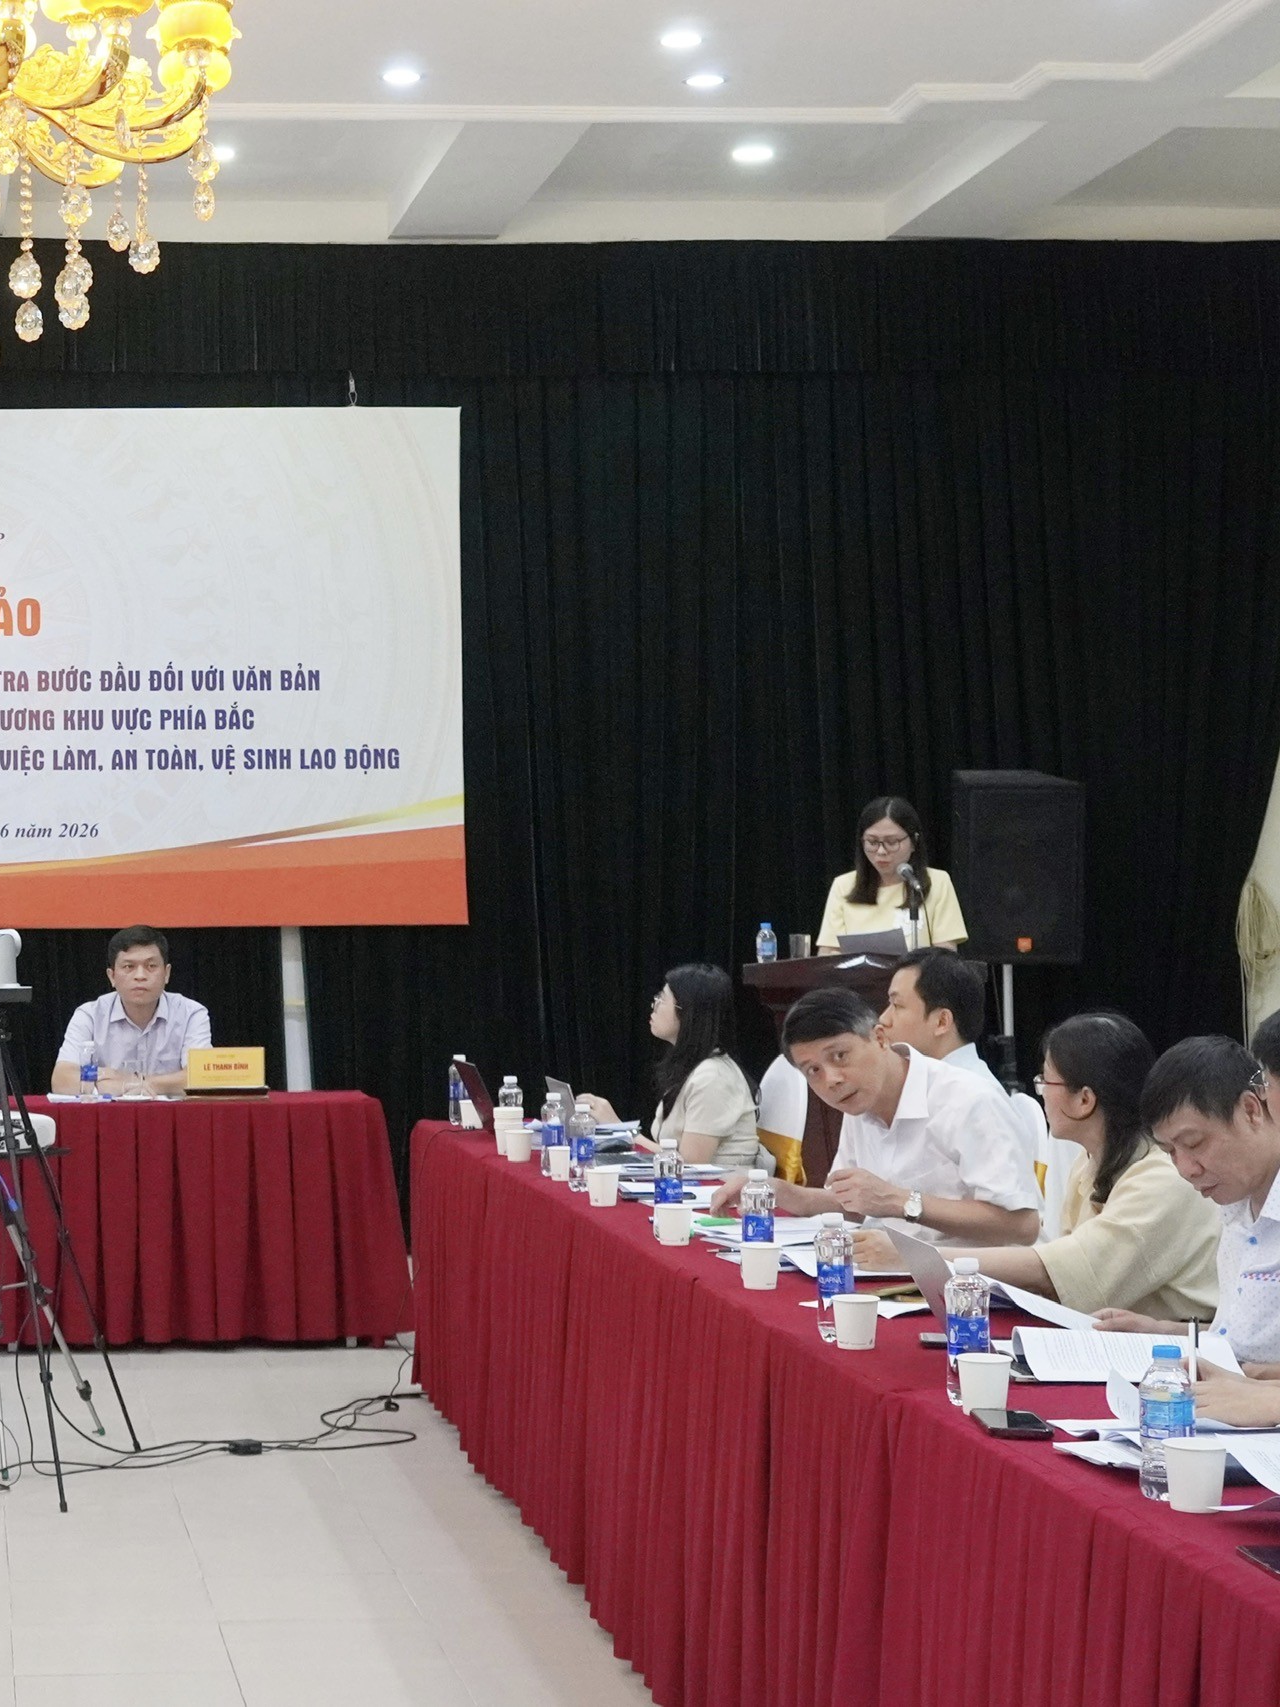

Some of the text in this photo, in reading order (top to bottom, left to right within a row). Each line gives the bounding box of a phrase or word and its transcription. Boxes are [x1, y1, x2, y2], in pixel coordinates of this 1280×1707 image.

[37, 666, 91, 692] BƯỚC
[100, 662, 140, 691] ĐẦU
[148, 662, 183, 691] ĐỐI
[192, 665, 224, 691] VỚI
[233, 666, 271, 691] VĂN
[281, 663, 320, 691] BẢN
[64, 710, 103, 730] KHU
[112, 708, 151, 735] VỰC
[160, 705, 206, 730] PHÍA
[215, 702, 254, 730] BẮC
[0, 745, 44, 776] VIỆC
[53, 745, 103, 774] LÀM,
[112, 750, 137, 770] AN
[145, 745, 203, 773] TOÀN,
[212, 745, 235, 775] VỆ
[244, 749, 291, 770] SINH
[300, 749, 336, 769] LAO
[344, 744, 399, 774] ĐỘNG
[0, 823, 10, 838] 6
[14, 823, 52, 838] năm
[58, 822, 99, 838] 2026
[212, 1063, 232, 1071] THANH
